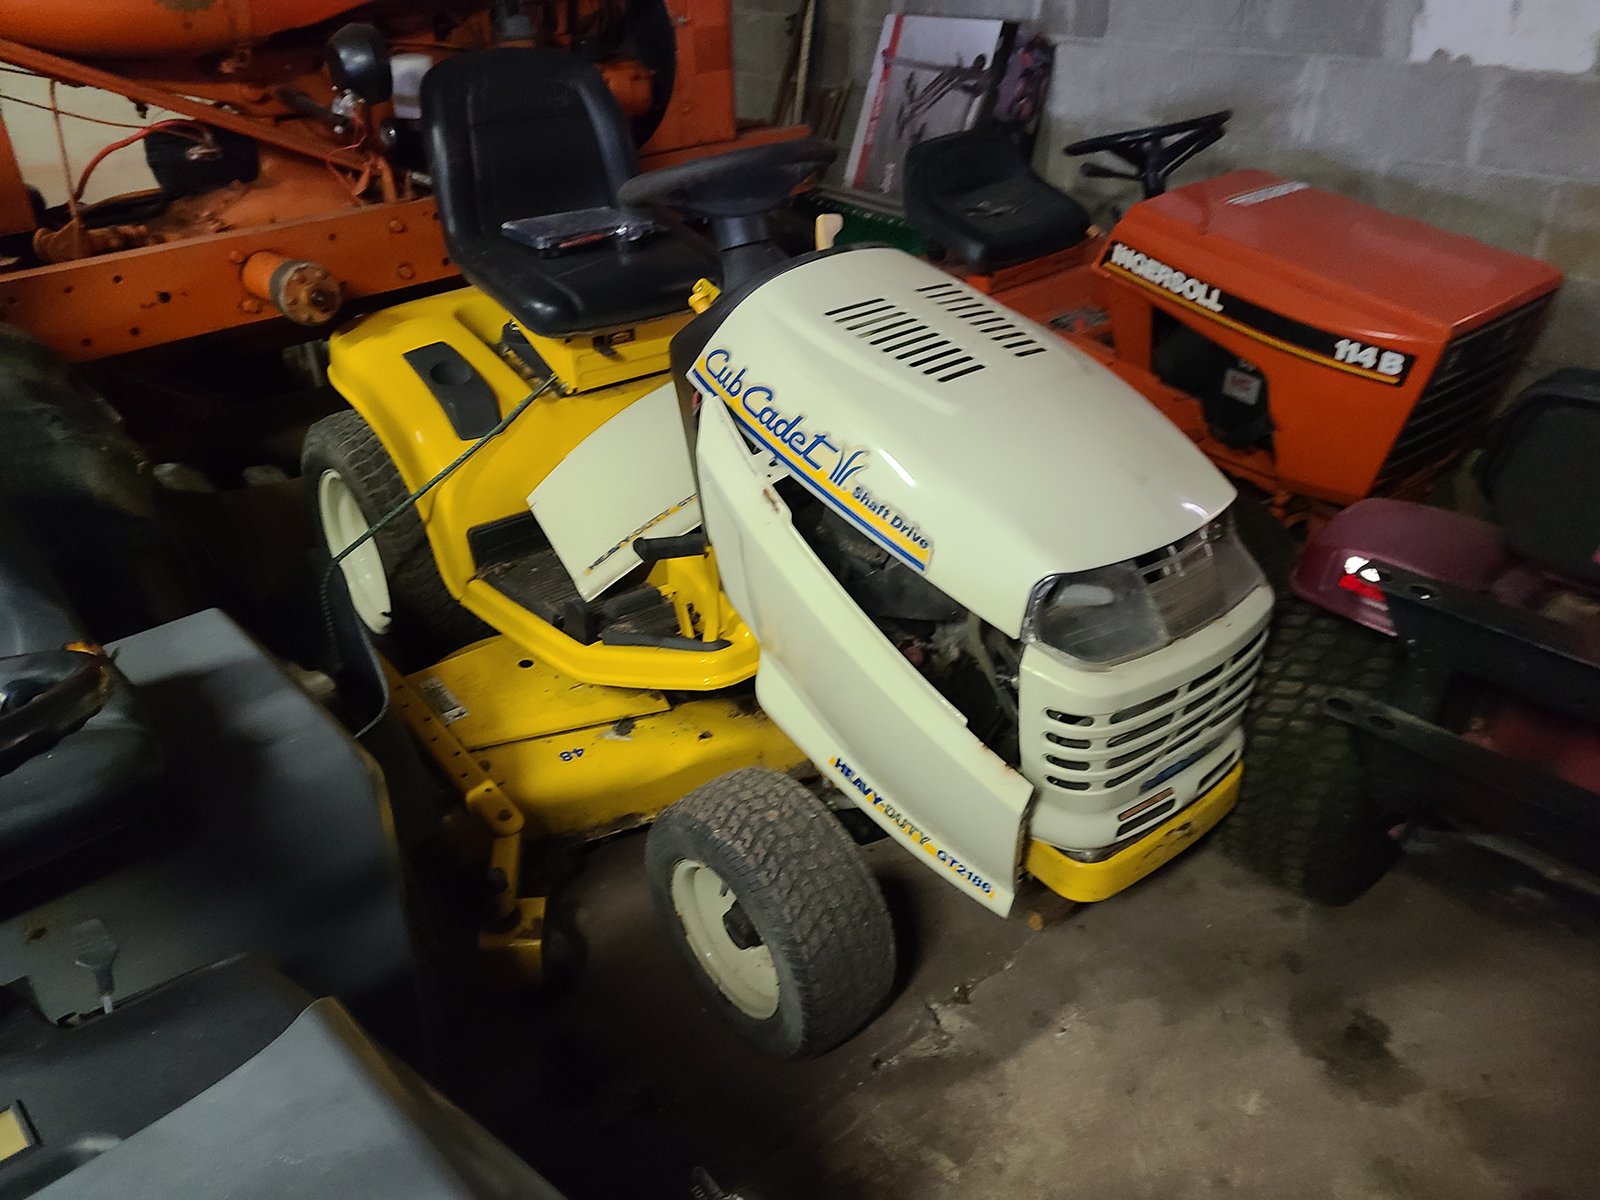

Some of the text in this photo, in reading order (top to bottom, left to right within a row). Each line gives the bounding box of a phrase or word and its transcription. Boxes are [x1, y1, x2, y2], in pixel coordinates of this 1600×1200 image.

[1334, 338, 1379, 369] 114
[1377, 350, 1405, 376] B
[705, 349, 839, 470] Cub Cadet
[852, 486, 930, 550] Shaft Drive
[936, 850, 993, 894] GT2186
